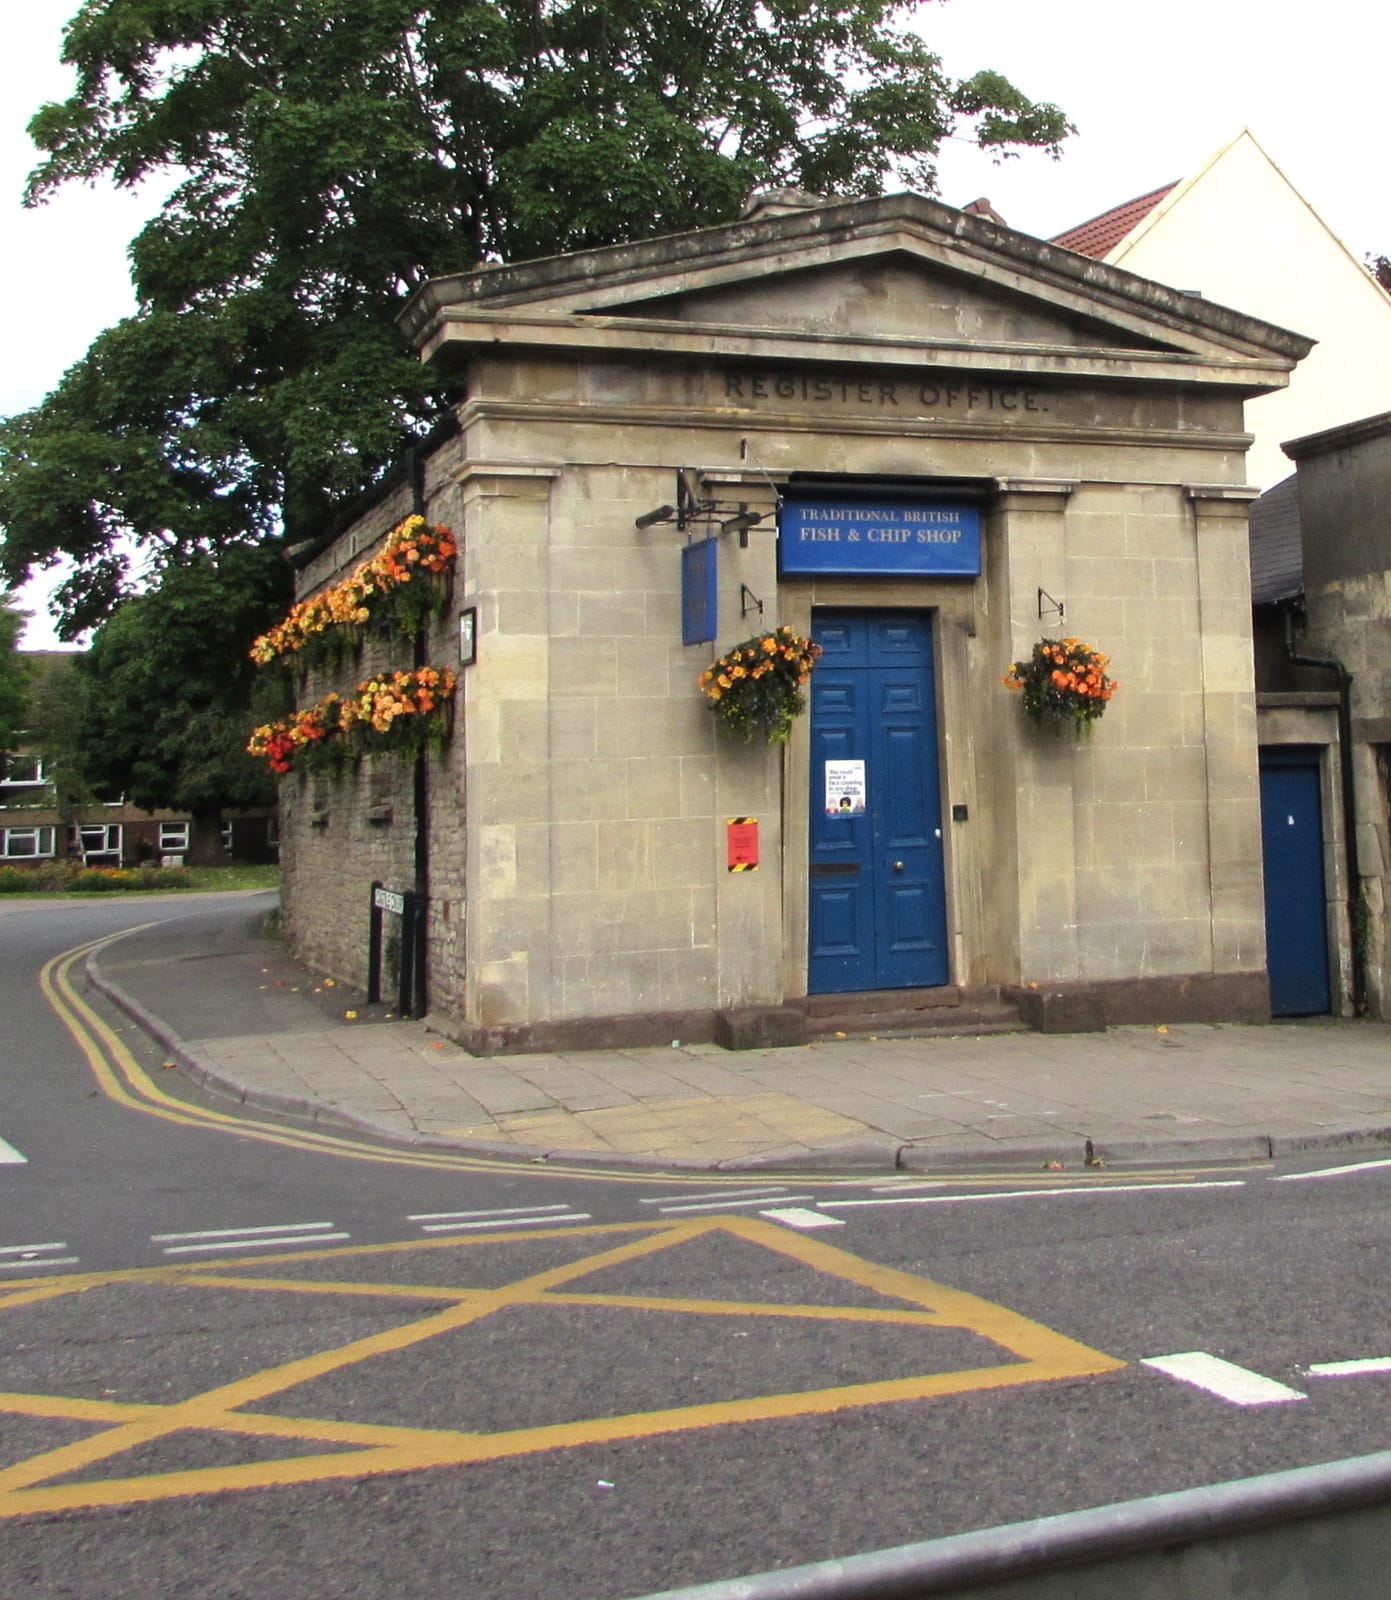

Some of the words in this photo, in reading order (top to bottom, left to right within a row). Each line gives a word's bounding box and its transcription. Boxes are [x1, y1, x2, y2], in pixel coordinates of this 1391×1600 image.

[724, 375, 898, 405] REGISTER
[800, 508, 898, 522] TRADITIONAL
[904, 511, 960, 523] BRITISH
[800, 527, 840, 541] FISH
[848, 528, 860, 541] &
[867, 529, 911, 543] CHIP
[917, 530, 961, 544] SHOP
